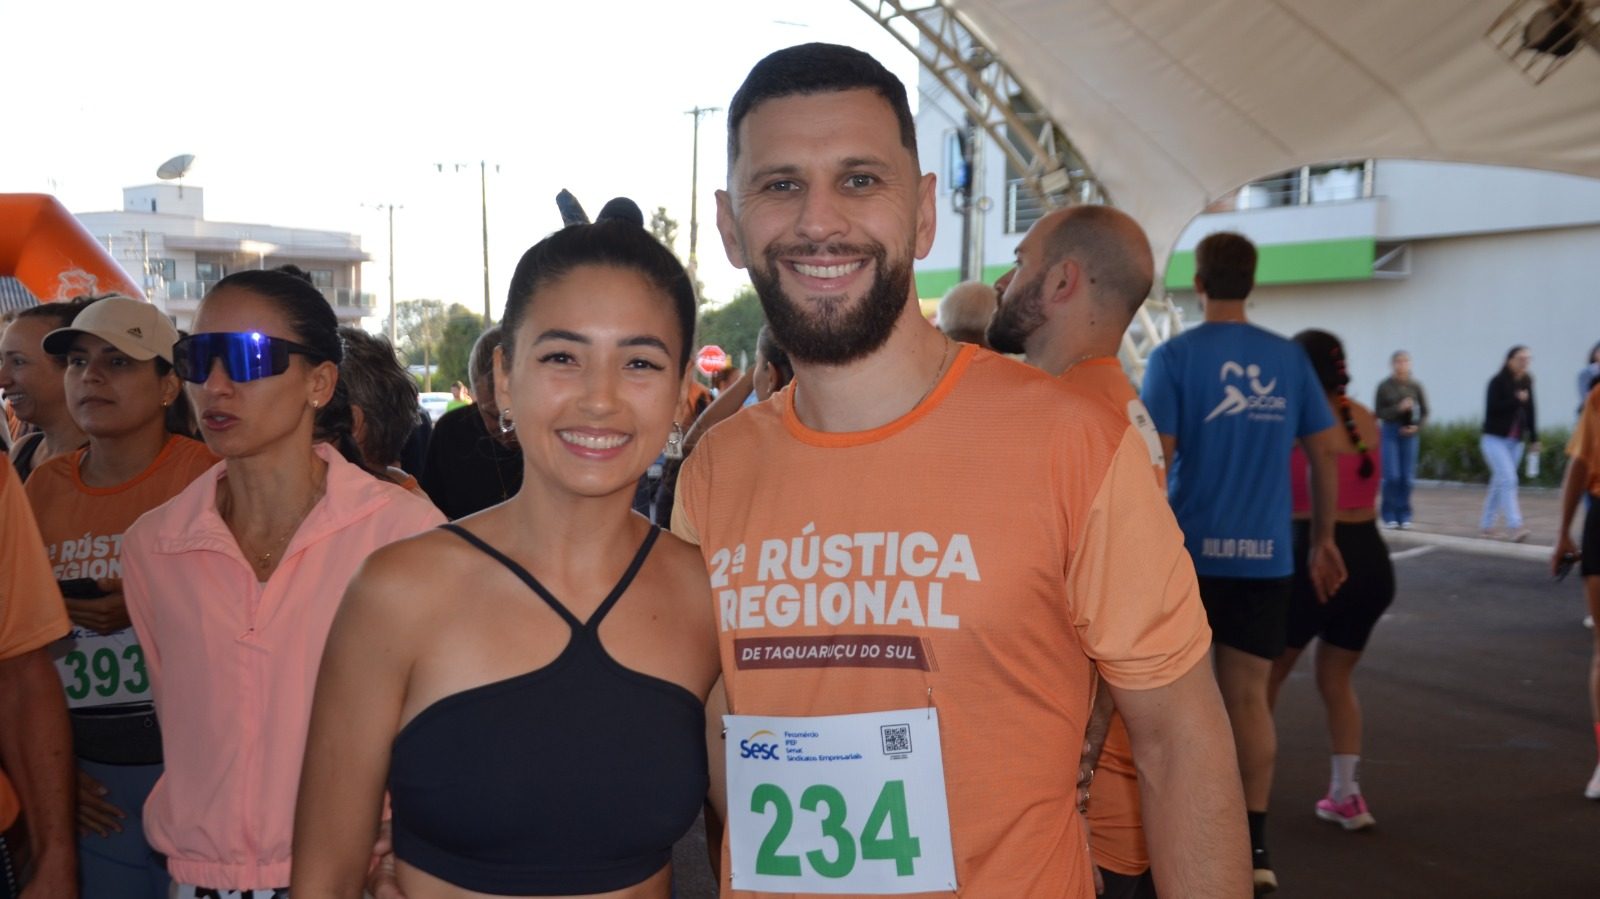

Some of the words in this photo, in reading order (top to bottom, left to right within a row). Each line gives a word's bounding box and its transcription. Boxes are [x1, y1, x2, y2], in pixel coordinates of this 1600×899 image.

[61, 531, 125, 562] RÚST
[710, 543, 746, 588] 2ª
[757, 521, 981, 582] RÚSTICA
[1203, 538, 1235, 556] JULIO
[719, 580, 960, 632] REGIONAL
[742, 647, 761, 661] DE
[765, 644, 856, 660] TAQUARUÇU
[860, 644, 880, 658] DO
[885, 646, 916, 660] SUL
[64, 645, 149, 700] 393
[739, 738, 780, 761] Sesc
[787, 754, 817, 762] Sindicatos
[819, 752, 863, 762] Empresariais
[751, 780, 921, 878] 234
